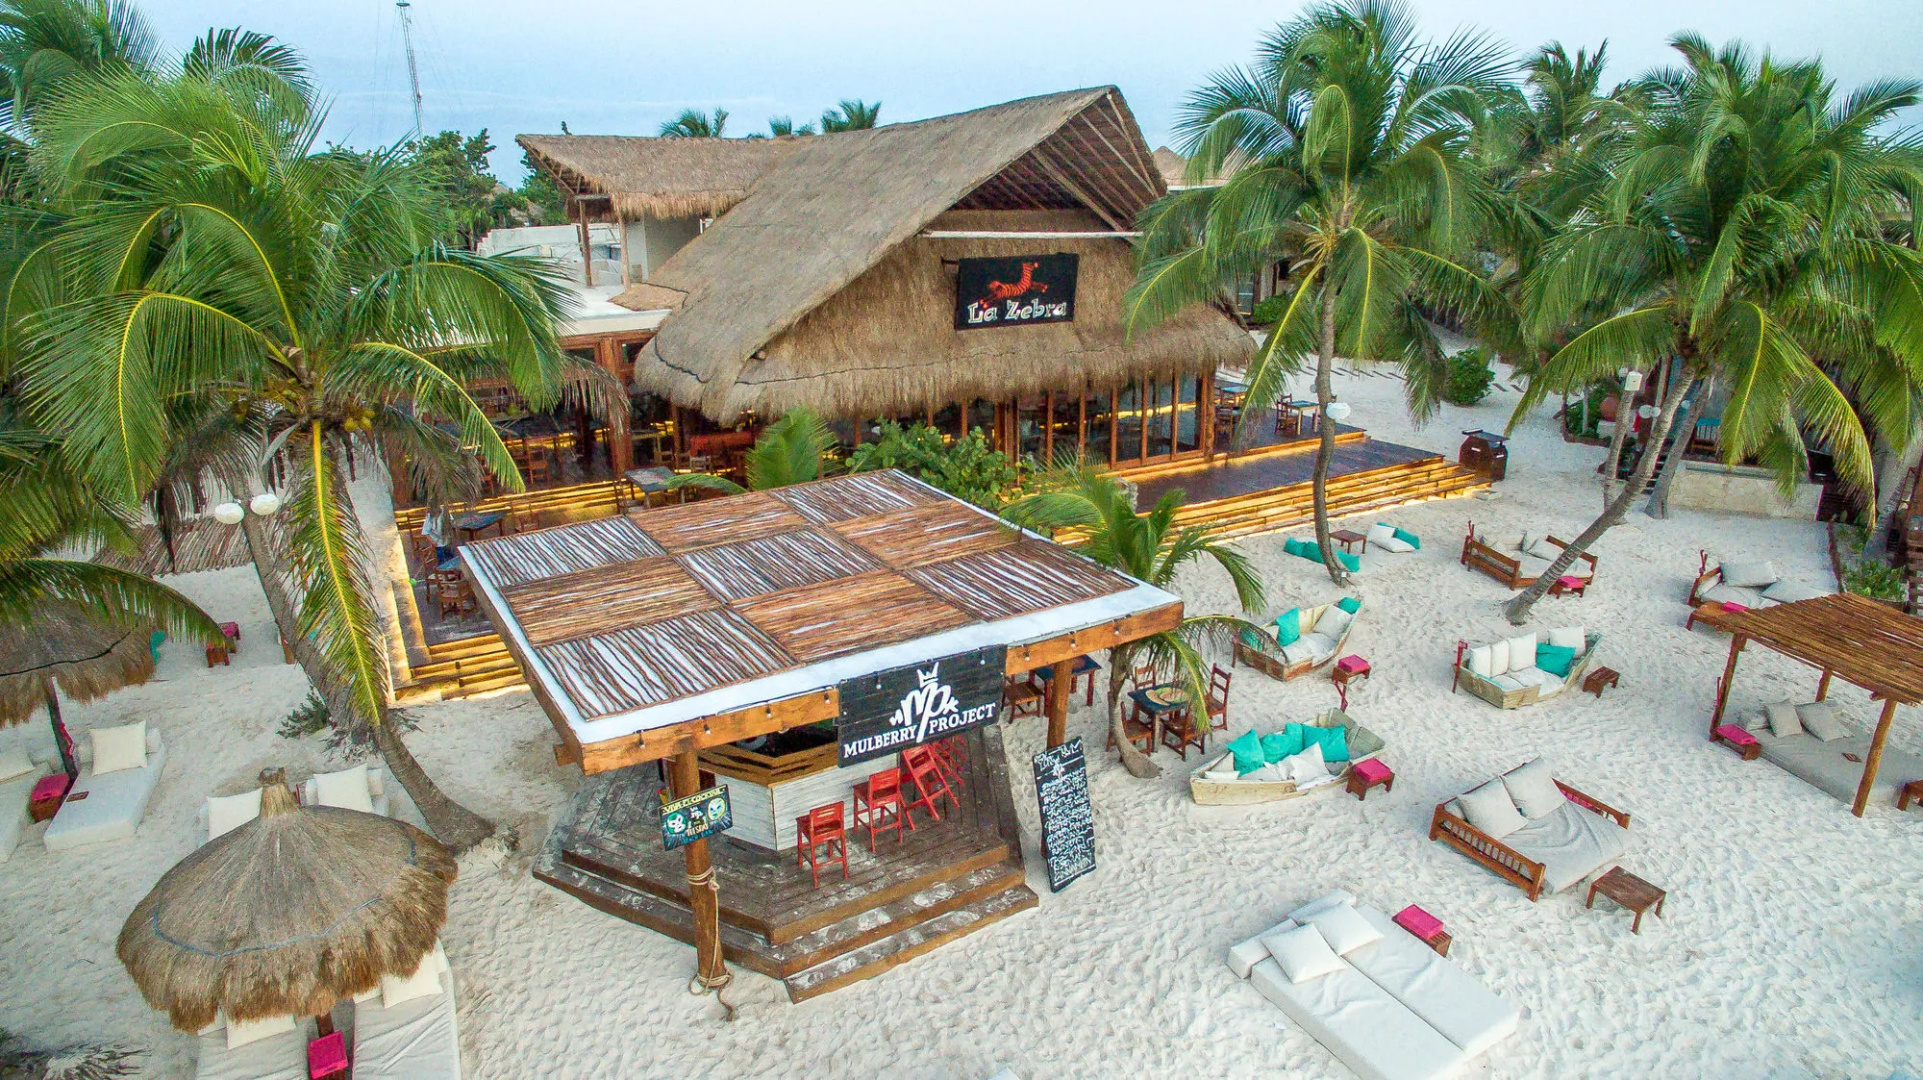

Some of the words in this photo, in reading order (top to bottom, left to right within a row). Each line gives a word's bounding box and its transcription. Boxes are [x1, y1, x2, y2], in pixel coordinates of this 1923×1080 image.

[967, 301, 998, 324] La
[1004, 298, 1067, 320] Zebra
[843, 724, 918, 758] MULBERRY
[929, 702, 996, 734] PROJECT
